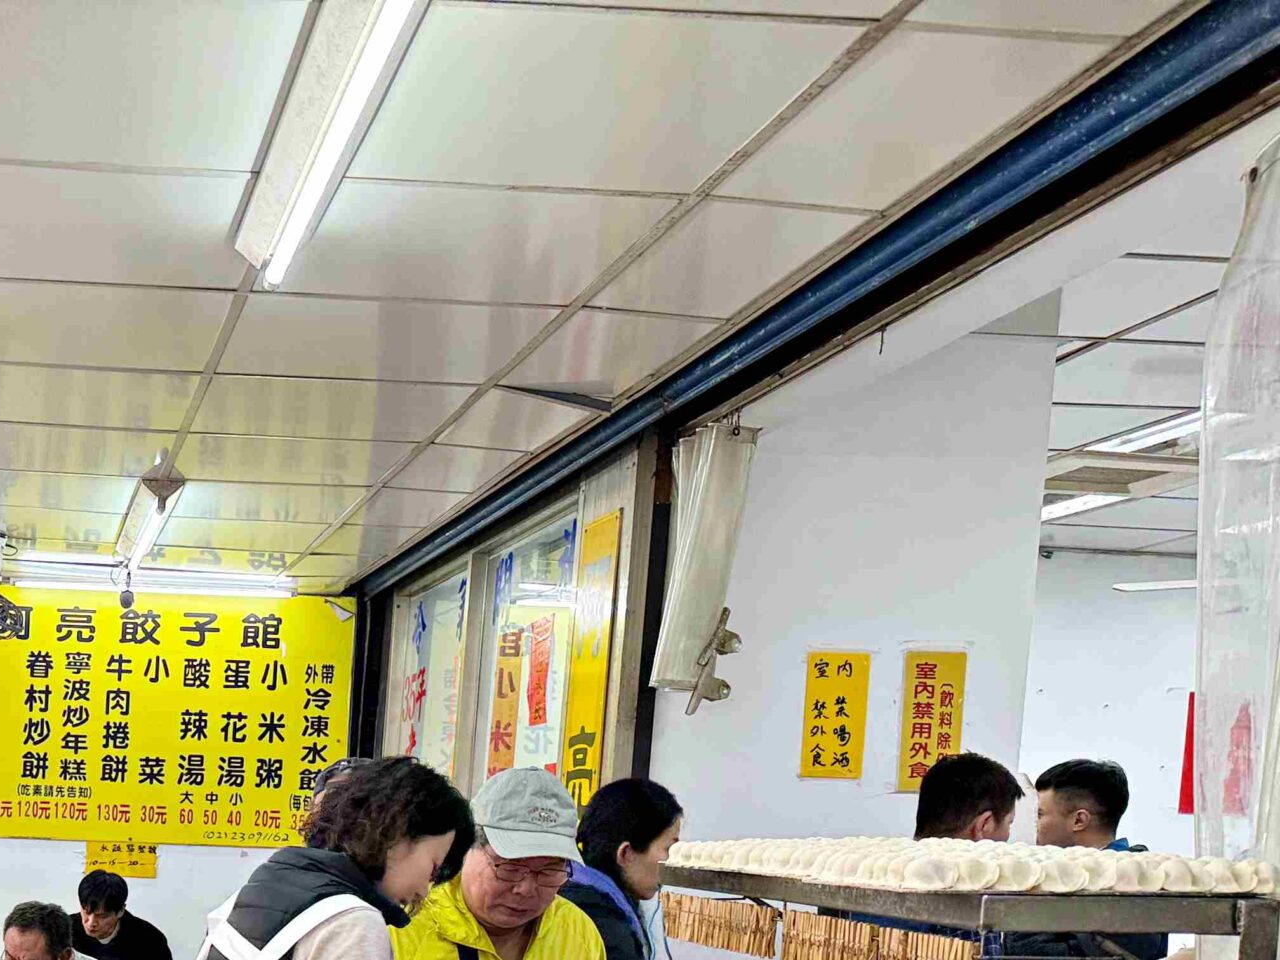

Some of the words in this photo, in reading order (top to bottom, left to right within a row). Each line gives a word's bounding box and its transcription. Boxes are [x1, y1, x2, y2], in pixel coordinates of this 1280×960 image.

[20, 650, 54, 780] 眷村炒餅
[58, 651, 92, 782] 寧波炒年糕
[99, 653, 133, 783] 牛肉捲餅
[177, 657, 211, 786] 酸辣湯
[217, 659, 251, 788] 蛋花湯
[255, 659, 288, 789] 小米粥
[17, 801, 50, 819] 120元
[54, 802, 87, 821] 120元
[97, 804, 130, 823] 130元
[141, 806, 167, 824] 30元
[179, 808, 193, 824] 60
[203, 809, 217, 825] 50
[227, 810, 241, 826] 40
[254, 809, 281, 829] 20元
